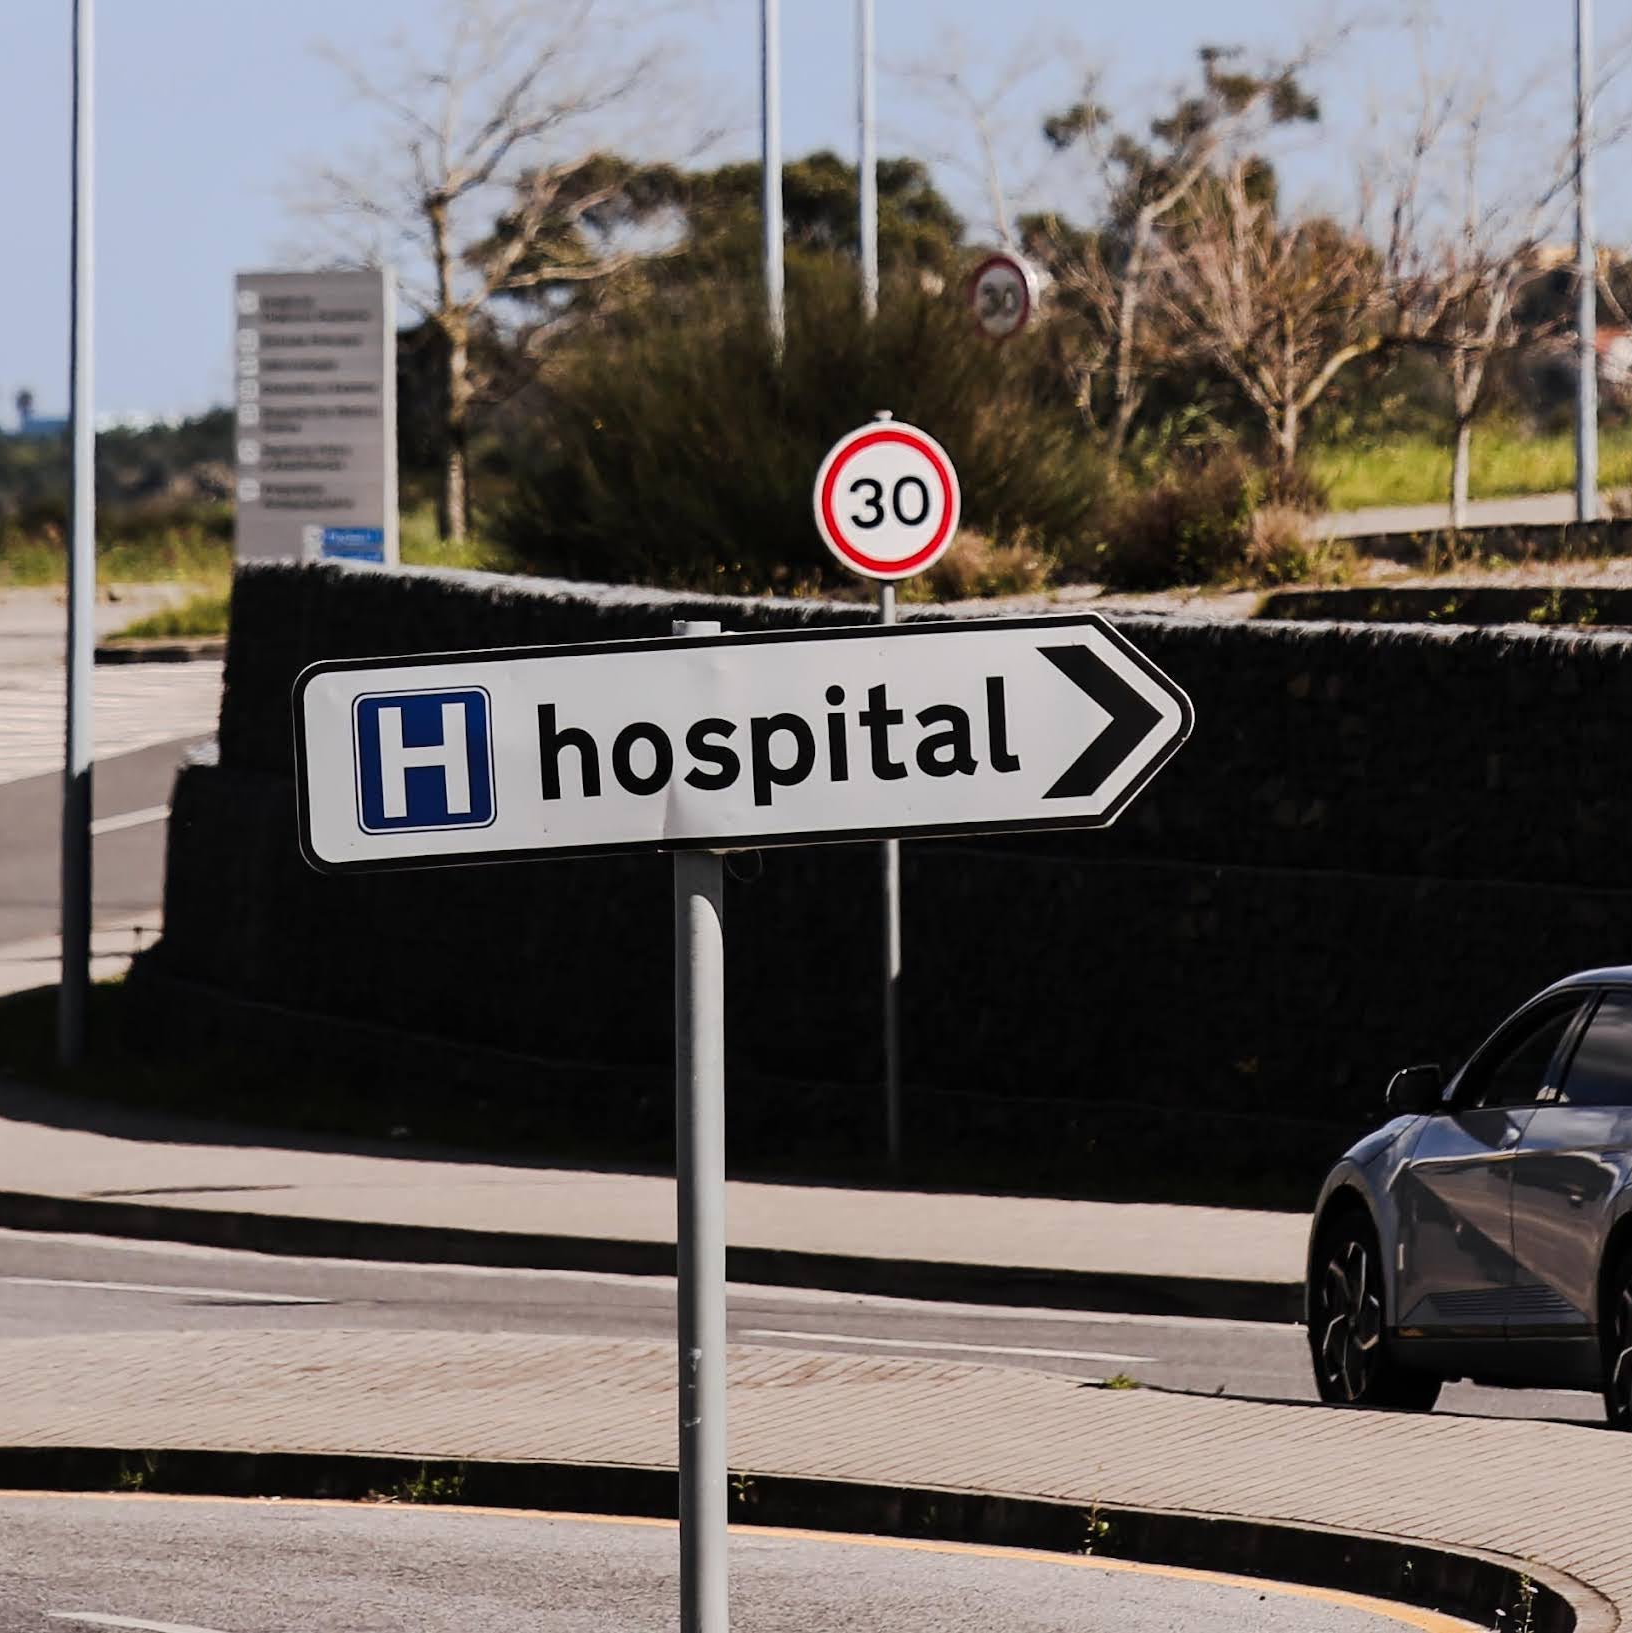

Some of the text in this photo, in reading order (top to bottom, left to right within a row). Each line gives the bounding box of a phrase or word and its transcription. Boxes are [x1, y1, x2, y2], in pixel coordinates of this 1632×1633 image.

[981, 282, 1022, 319] 30
[850, 476, 931, 530] 30
[378, 677, 1021, 819] H hospital
